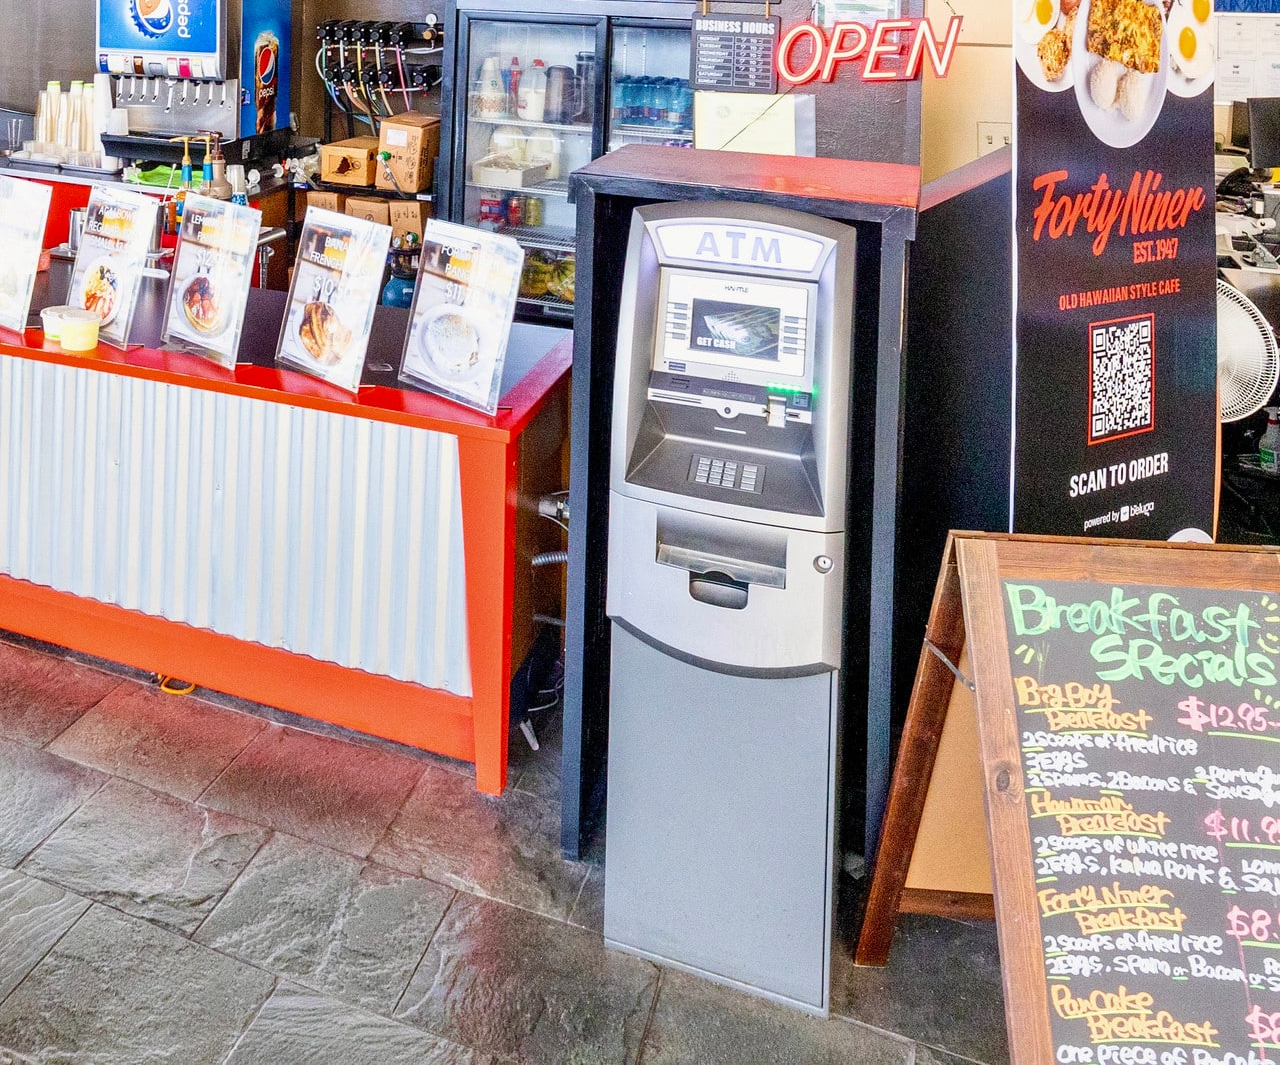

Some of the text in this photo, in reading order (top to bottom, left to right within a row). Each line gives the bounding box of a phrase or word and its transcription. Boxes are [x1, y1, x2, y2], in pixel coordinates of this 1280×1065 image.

[696, 19, 775, 35] BUSINESS HOURS
[777, 16, 963, 85] OPEN
[259, 86, 275, 100] pepsi
[1032, 169, 1206, 256] Forty Niner
[696, 231, 782, 263] ATM
[1059, 278, 1181, 311] OLD HAWAIIAN STYLE CAFE
[697, 336, 736, 350] GET CASH
[1069, 452, 1169, 498] SCAN TO ORDER
[1084, 511, 1111, 532] powered
[1111, 511, 1120, 523] by
[1005, 582, 1260, 647] Breakfast
[1044, 709, 1153, 731] Breakfast
[1095, 732, 1115, 749] of
[1056, 810, 1171, 836] Breakfast
[1103, 837, 1124, 853] of
[1181, 842, 1219, 863] rice
[1164, 860, 1214, 884] Pork
[1037, 881, 1175, 913] Forty Niner
[1075, 907, 1187, 934] Breakfast
[1115, 933, 1136, 950] of
[1182, 935, 1223, 955] rice
[1173, 966, 1188, 976] or
[1187, 954, 1248, 983] Bacon
[1051, 984, 1154, 1018] Pancake
[1087, 1010, 1219, 1047] Breakfast
